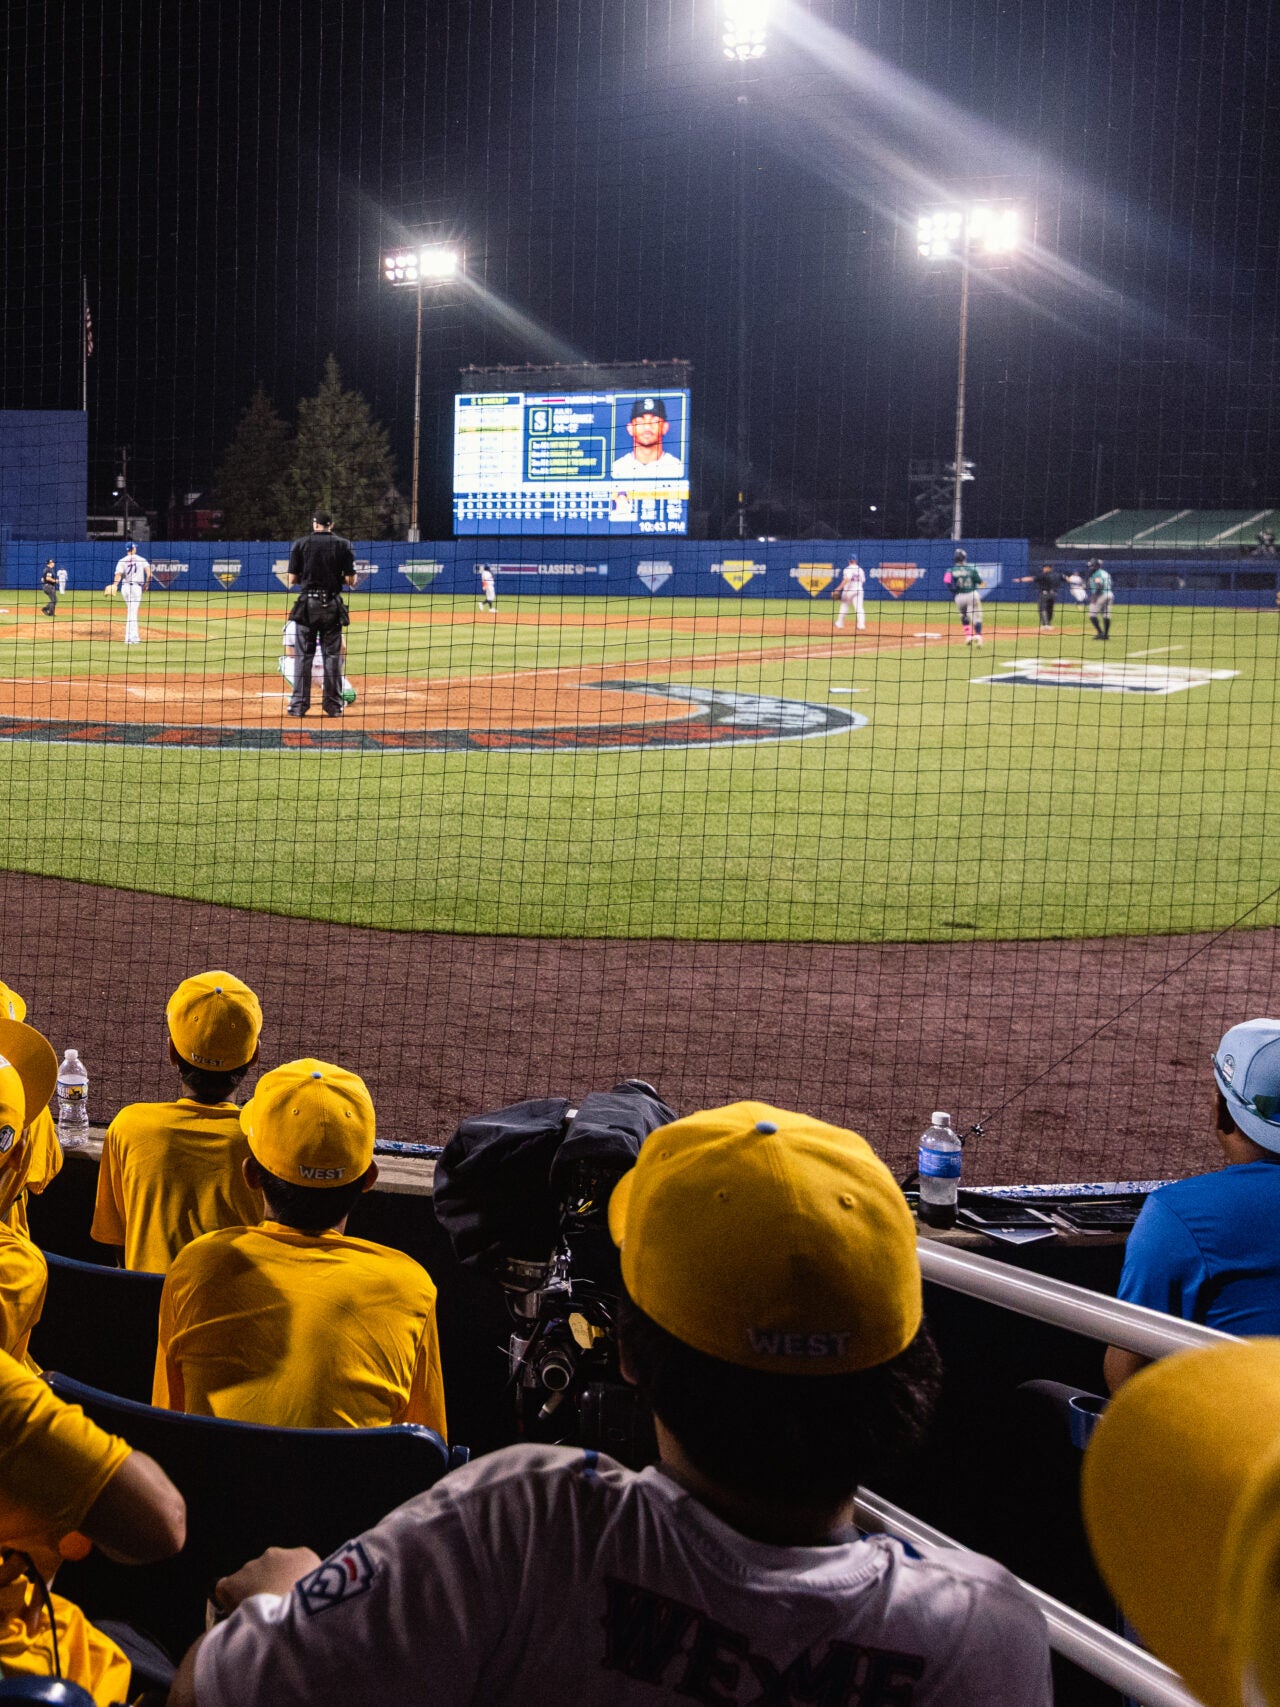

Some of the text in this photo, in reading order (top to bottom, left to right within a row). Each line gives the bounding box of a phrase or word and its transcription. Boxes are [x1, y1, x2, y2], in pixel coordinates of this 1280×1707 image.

[533, 411, 547, 431] S
[538, 563, 575, 575] CLASSIC
[191, 1052, 225, 1067] WEST
[299, 1164, 346, 1180] WEST
[747, 1327, 851, 1360] WEST
